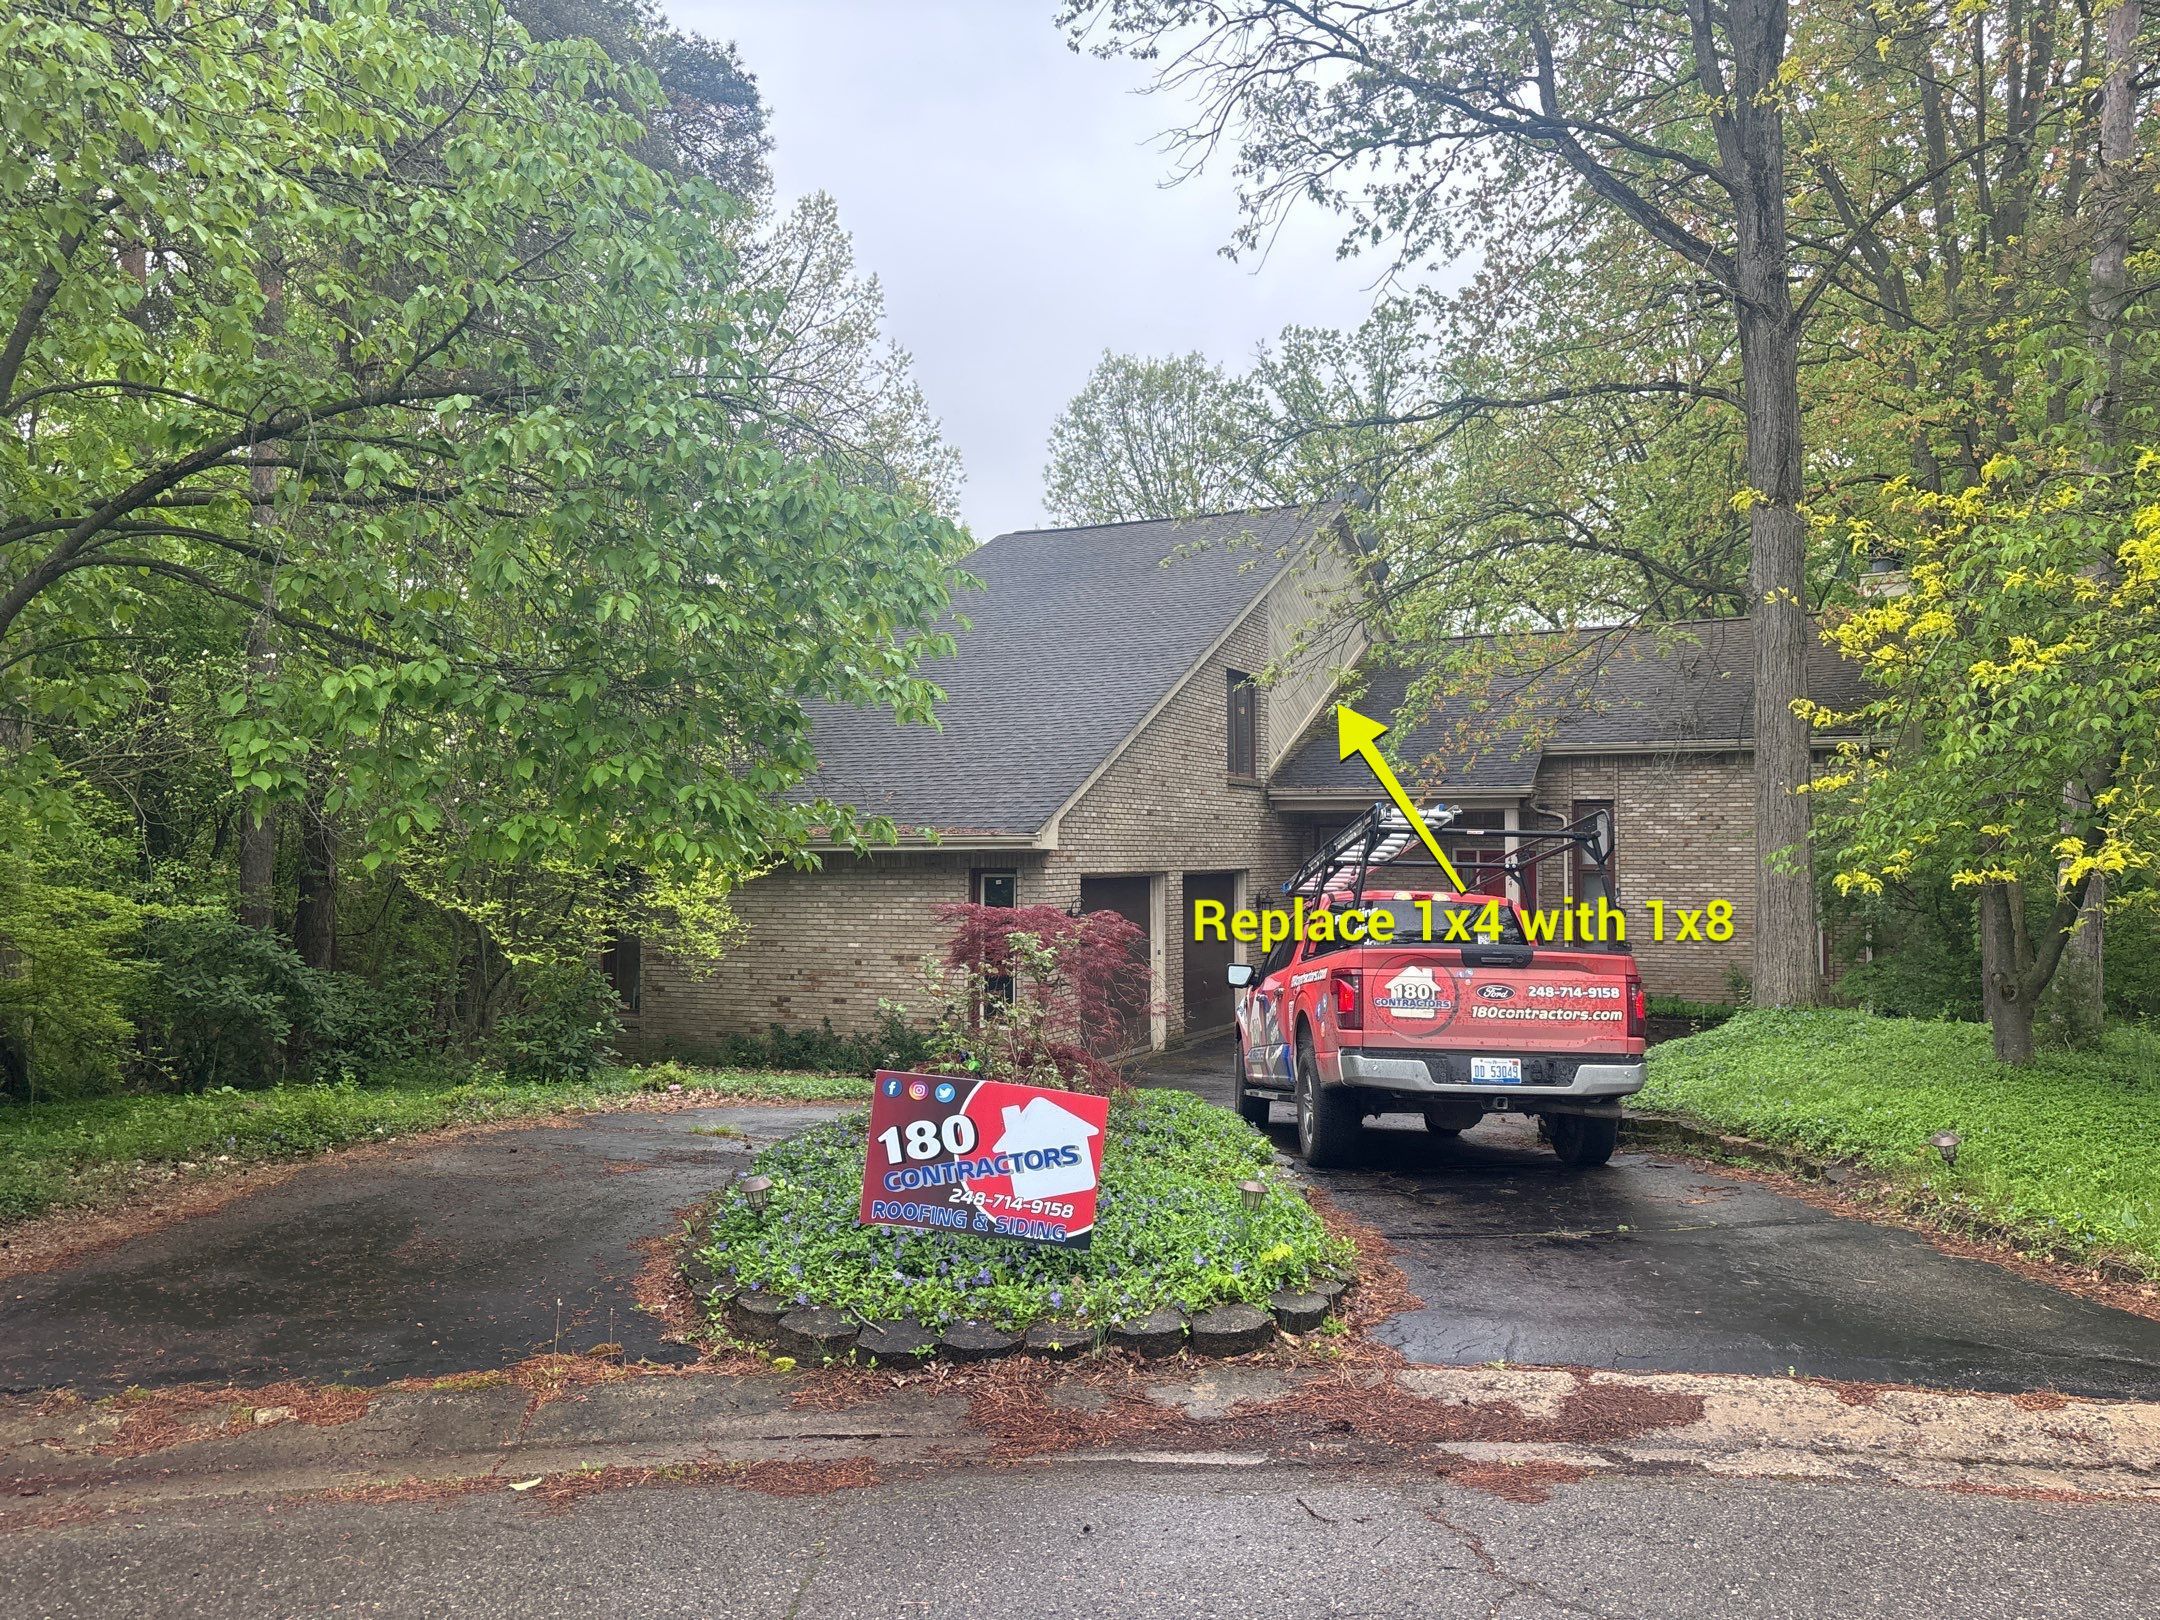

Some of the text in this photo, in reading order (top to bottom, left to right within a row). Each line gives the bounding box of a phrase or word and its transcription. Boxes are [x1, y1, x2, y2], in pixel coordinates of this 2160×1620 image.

[1395, 984, 1431, 1000] 180
[1483, 986, 1509, 999] Ford
[1528, 985, 1620, 999] 248-714-9158
[1374, 998, 1451, 1009] CONTRACTORS
[1472, 1005, 1623, 1021] 180contractors.com
[877, 1113, 977, 1165] 180
[884, 1145, 1081, 1192] CONTRACTORS
[948, 1188, 1075, 1219] 248-714-9158
[871, 1200, 1068, 1242] ROOFING & SIDING
